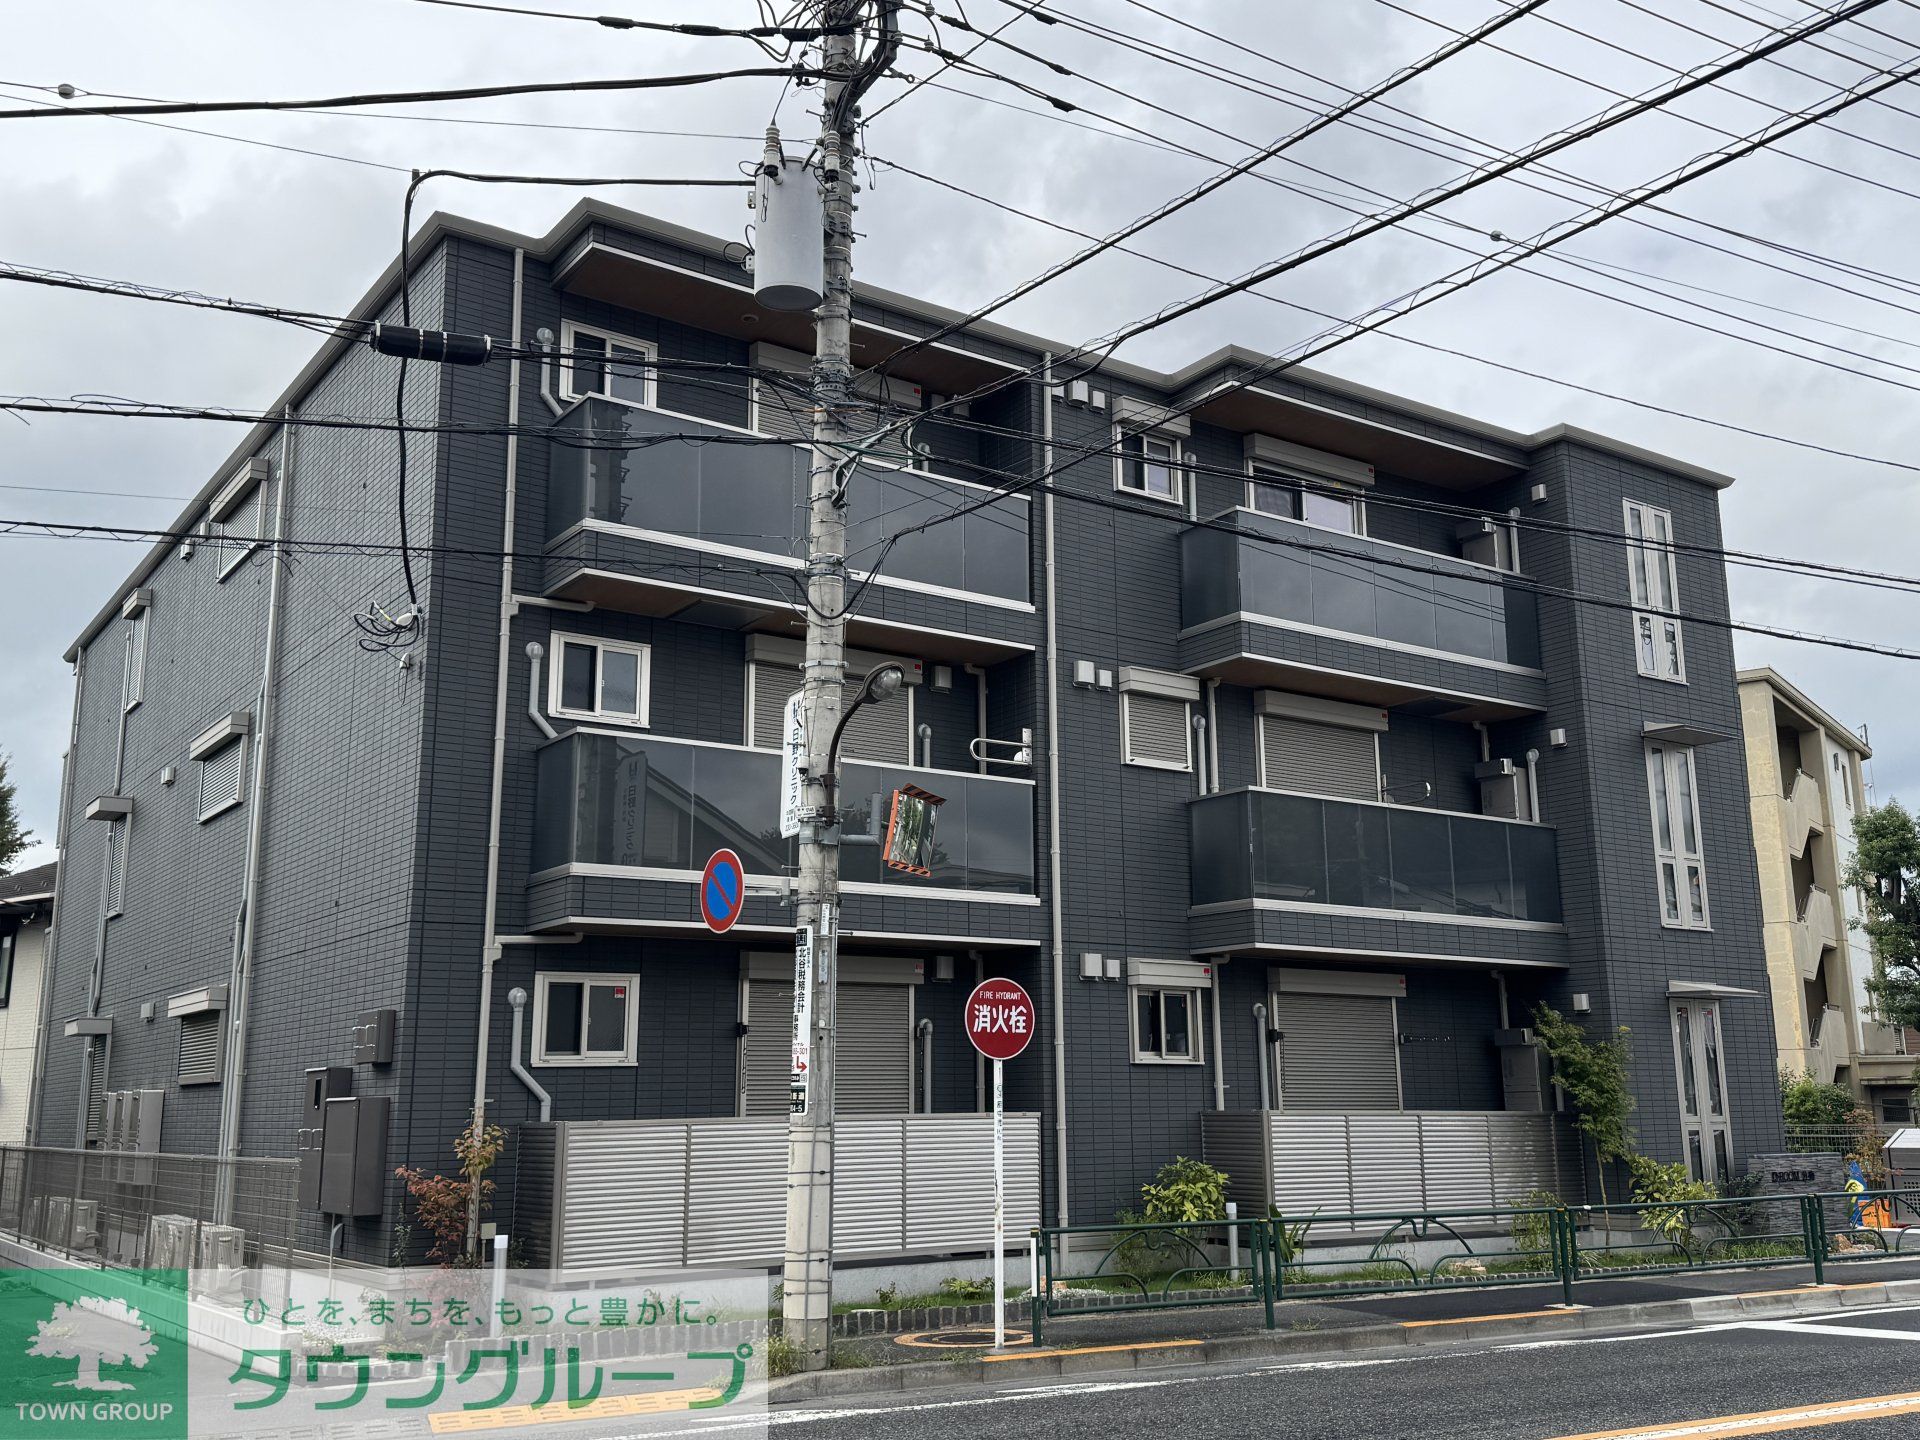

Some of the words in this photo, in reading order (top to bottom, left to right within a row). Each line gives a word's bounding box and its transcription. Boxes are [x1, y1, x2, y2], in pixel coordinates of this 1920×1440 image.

[979, 990, 994, 1000] FIRE
[995, 991, 1022, 1001] HYDRANT
[973, 1003, 1028, 1034] 消火栓
